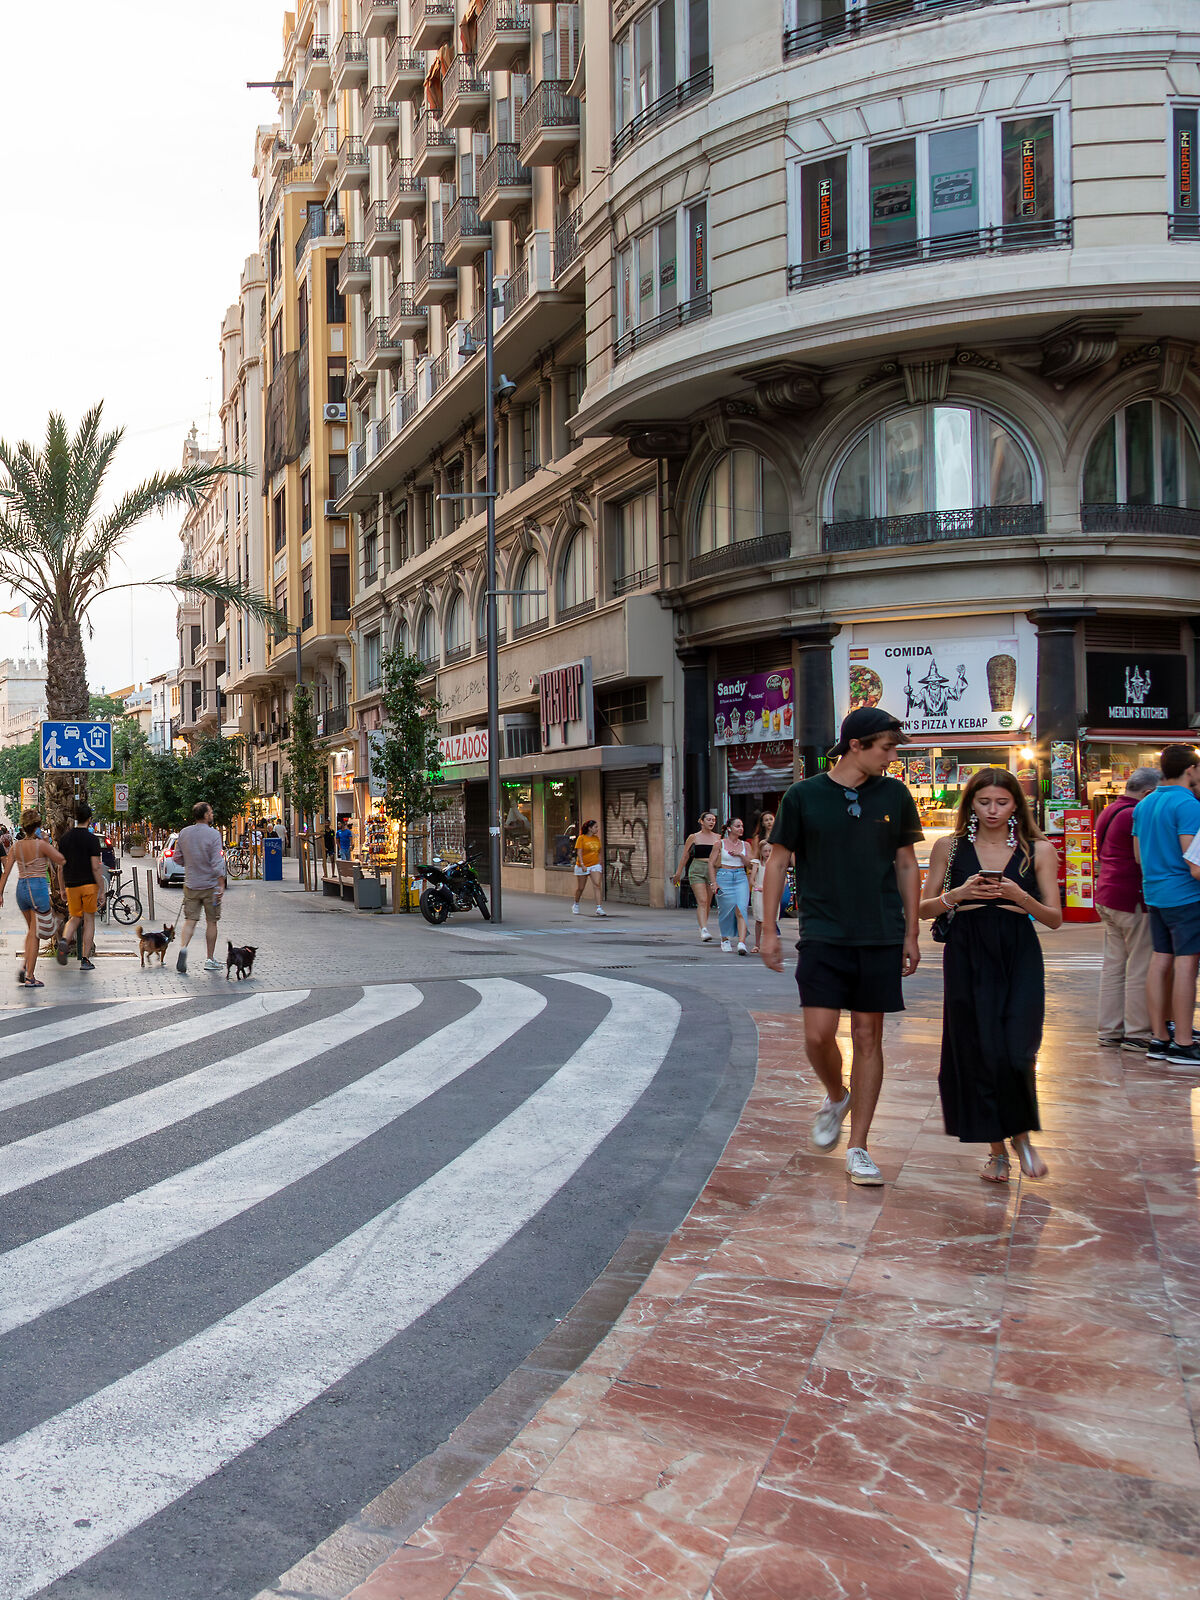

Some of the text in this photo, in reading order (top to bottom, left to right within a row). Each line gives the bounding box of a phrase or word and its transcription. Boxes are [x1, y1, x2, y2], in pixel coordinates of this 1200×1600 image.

[885, 646, 933, 657] COMIDA
[717, 680, 746, 697] Sandy
[1108, 706, 1168, 719] MERLIN'S KITCHEN
[902, 720, 920, 730] IN'S
[922, 719, 947, 730] PIZZA
[950, 719, 956, 729] Y
[958, 718, 988, 729] KEBAP
[439, 732, 488, 763] CALZADOS
